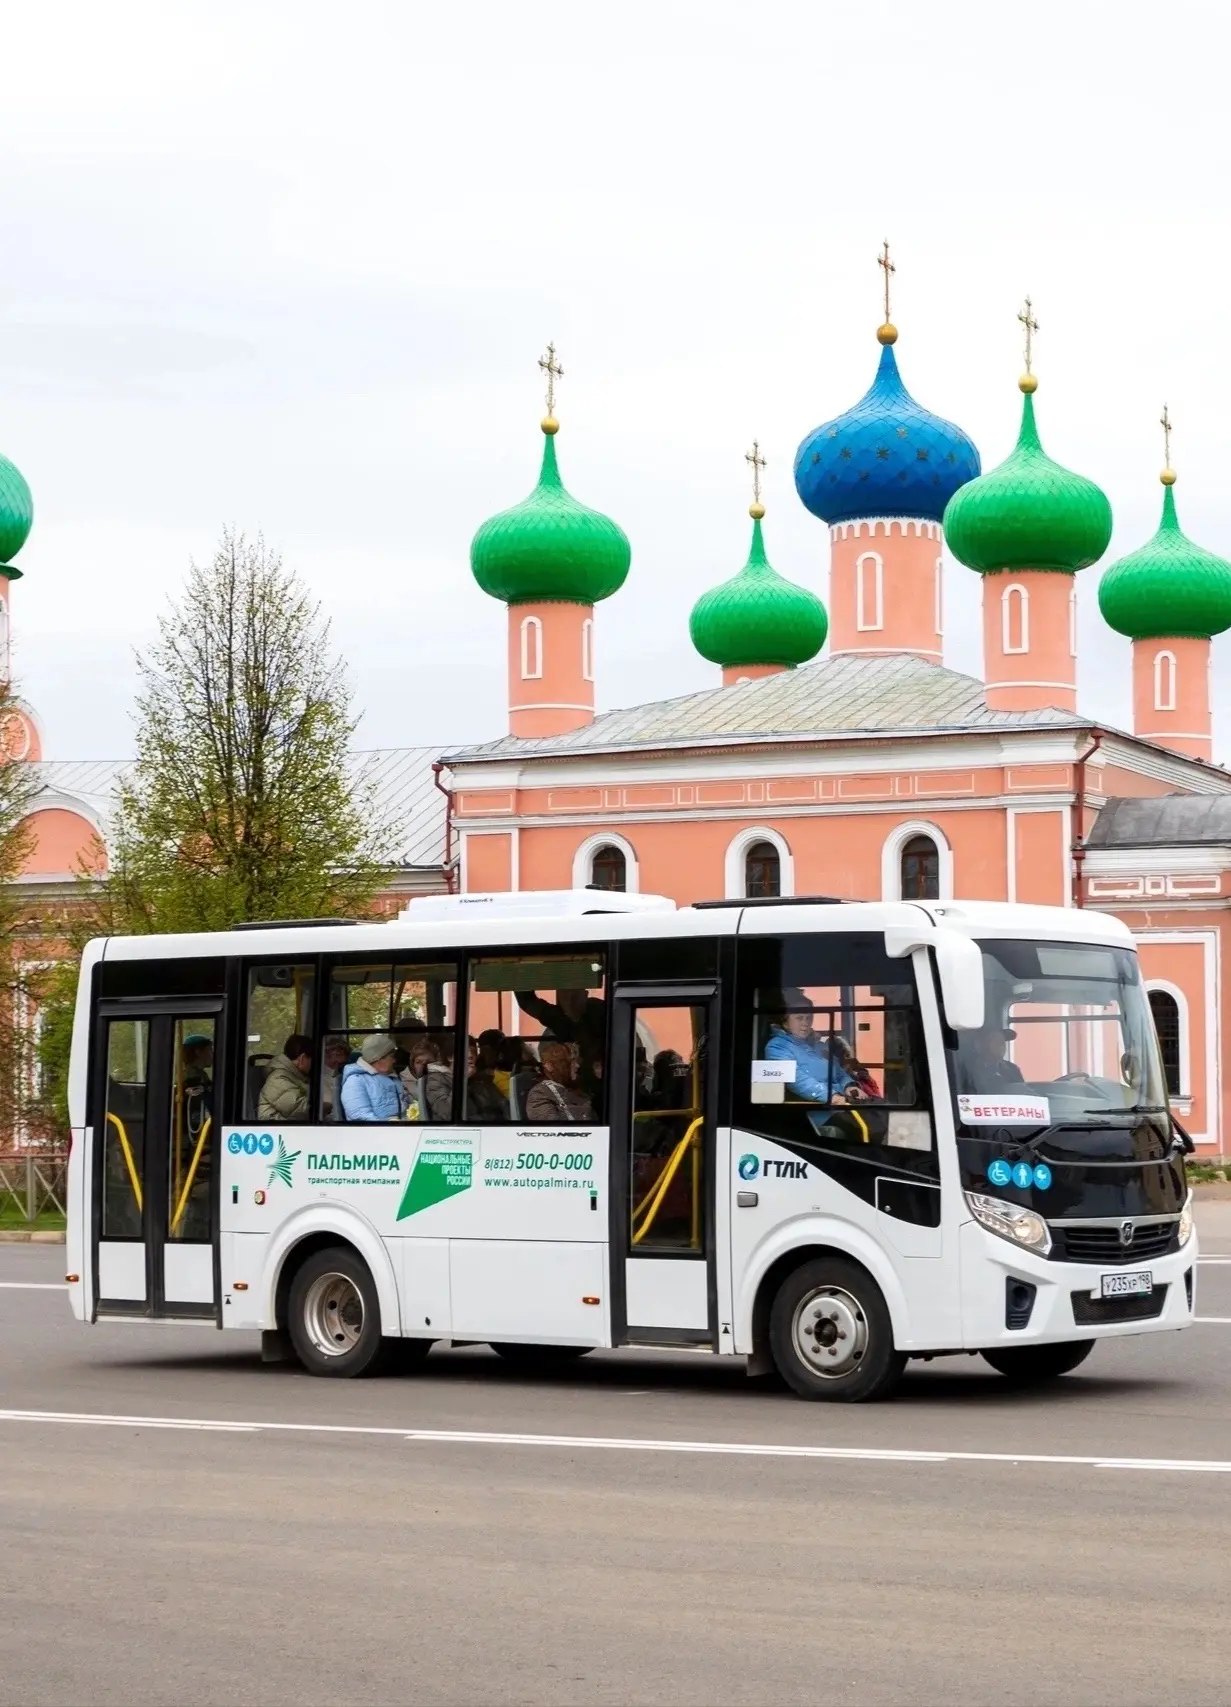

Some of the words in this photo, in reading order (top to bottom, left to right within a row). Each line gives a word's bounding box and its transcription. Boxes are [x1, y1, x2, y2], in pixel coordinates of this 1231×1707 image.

[973, 1107, 1045, 1119] ВЕТЕРАНЫ
[307, 1154, 400, 1171] ПАЛЬМИРА
[420, 1154, 471, 1164] НАЦИОНАЛЬНЫЕ
[484, 1158, 514, 1171] 8(812)
[516, 1153, 593, 1171] 500-0-000
[441, 1165, 471, 1175] ПРОЕКТЫ
[763, 1159, 808, 1180] ГТЛК
[307, 1177, 360, 1185] транспортная
[446, 1175, 471, 1186] РОССИИ
[484, 1177, 594, 1189] www.autopalmira.ru
